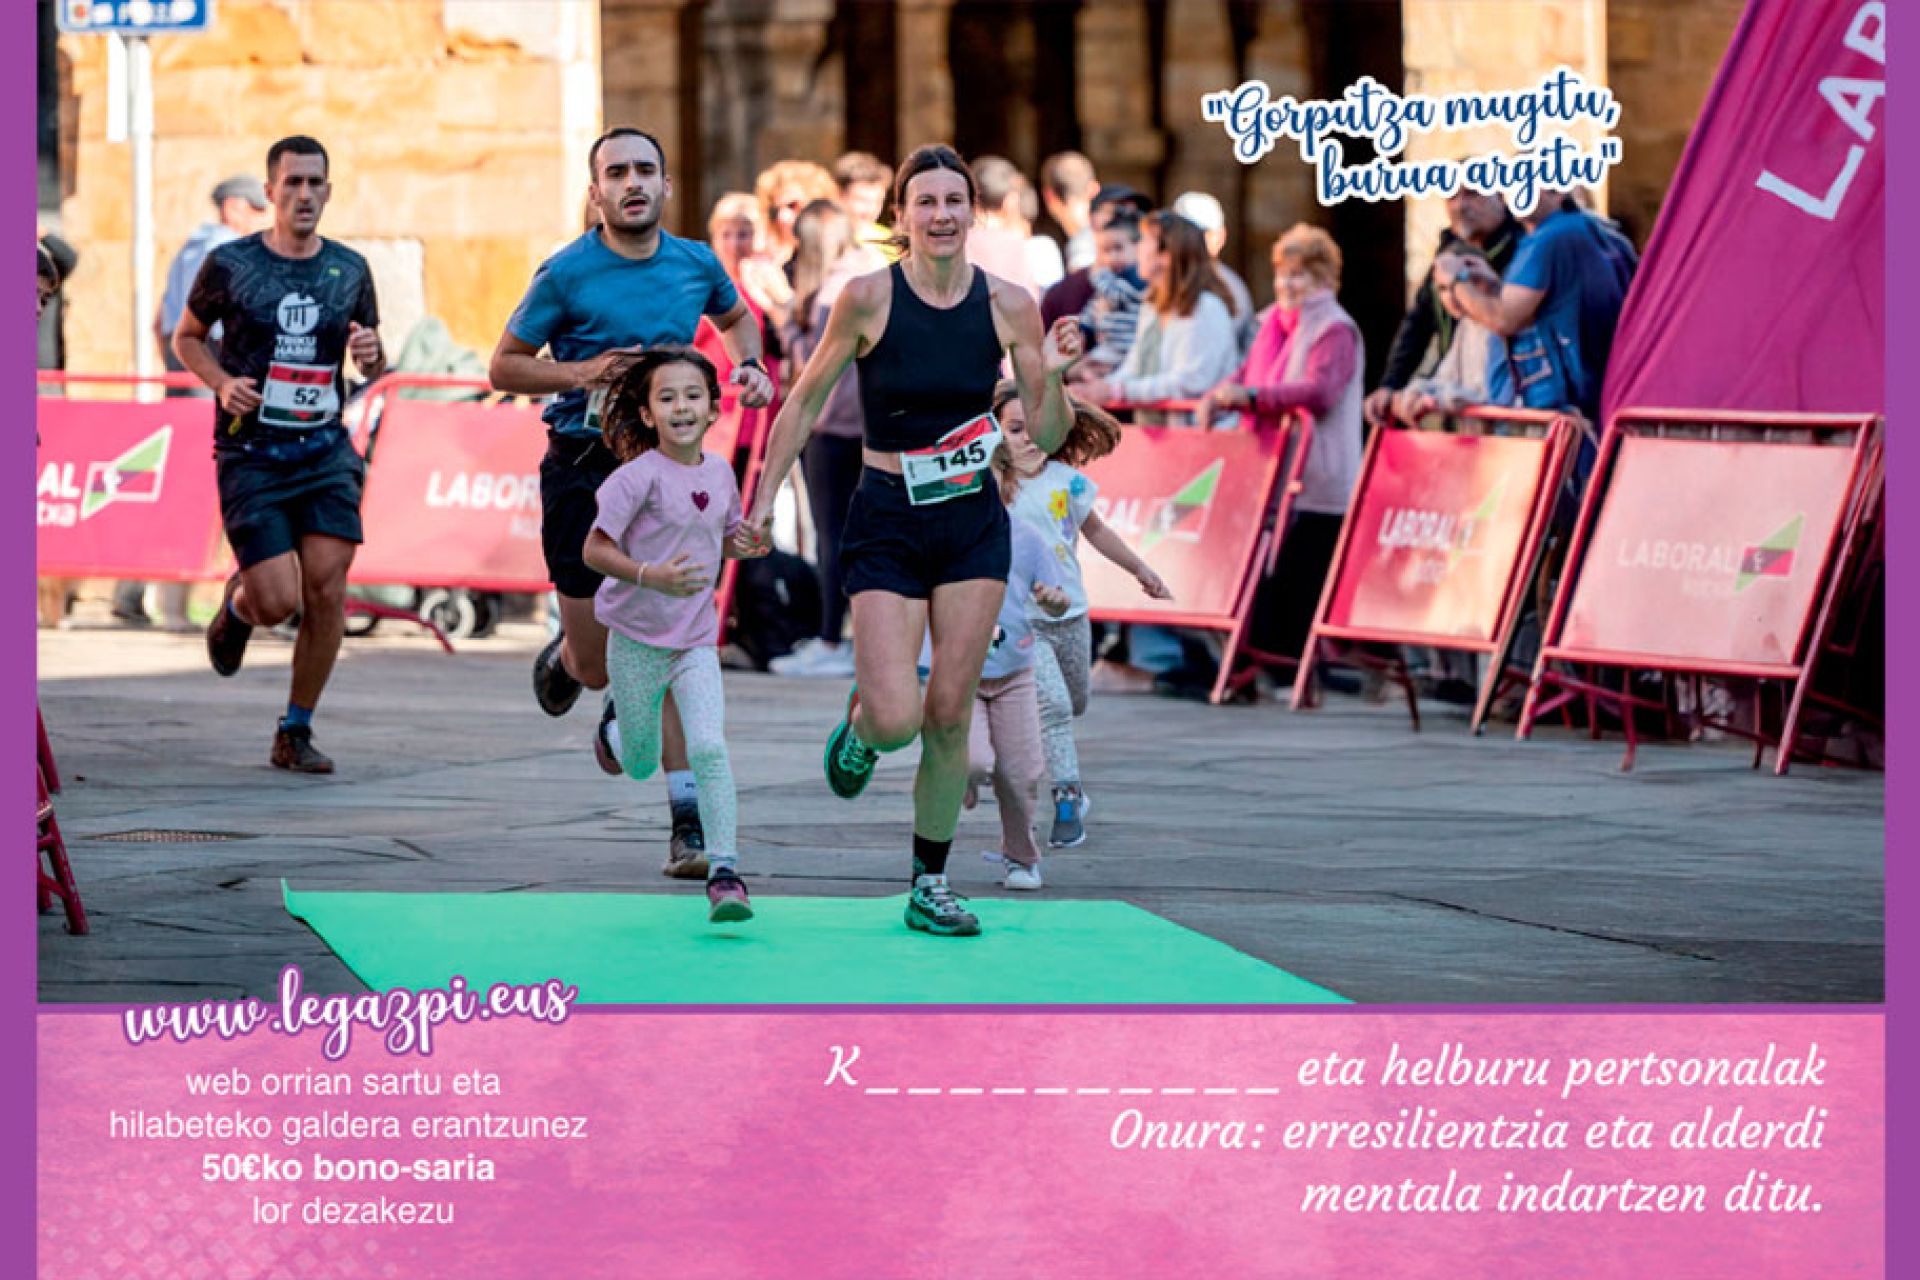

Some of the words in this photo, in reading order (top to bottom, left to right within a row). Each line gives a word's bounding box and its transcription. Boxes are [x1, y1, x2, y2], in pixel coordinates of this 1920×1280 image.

[294, 387, 320, 405] 52
[932, 440, 986, 472] 145
[1617, 538, 1738, 572] LABORAL
